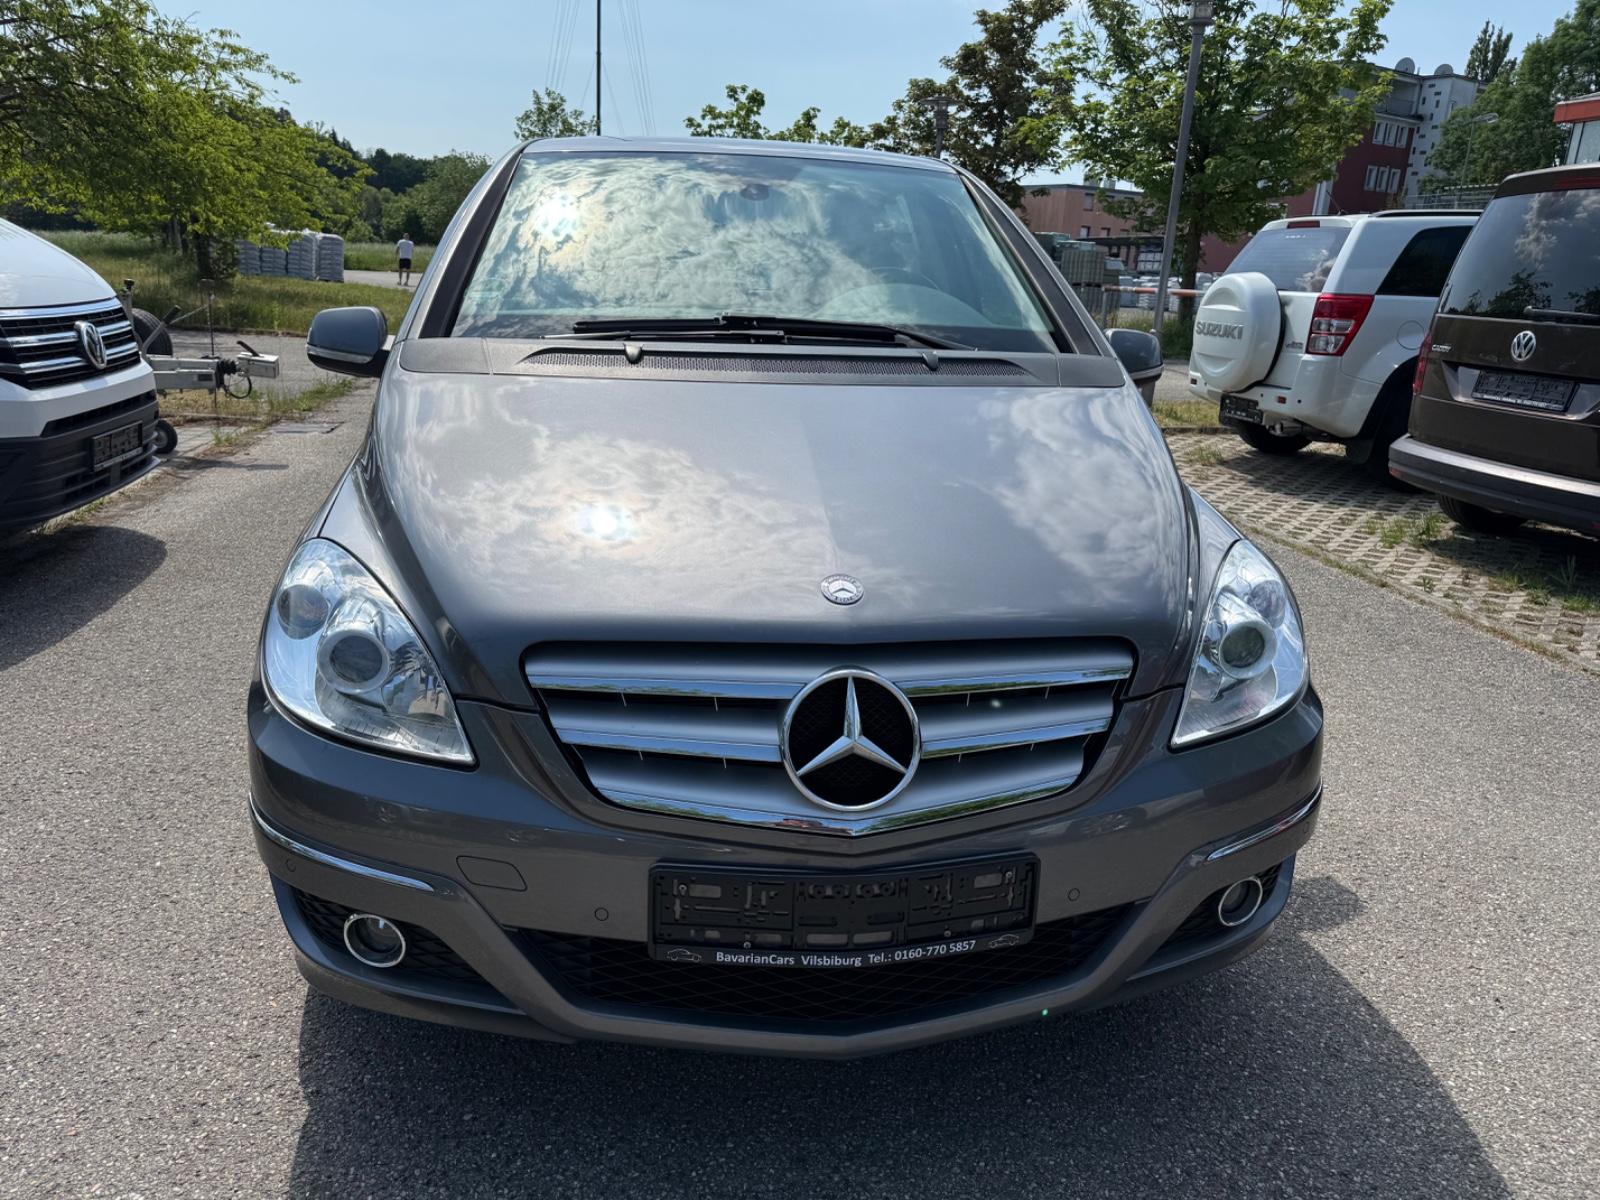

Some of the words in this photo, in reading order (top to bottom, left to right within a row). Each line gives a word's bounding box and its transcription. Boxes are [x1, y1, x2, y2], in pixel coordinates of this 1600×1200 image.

[1195, 321, 1244, 340] SUZUKI
[716, 951, 795, 966] BavarianCars
[801, 953, 862, 968] Vilsbiburg
[868, 952, 892, 964] Tel.:
[895, 946, 947, 960] 0160-770
[949, 940, 976, 953] 5857
